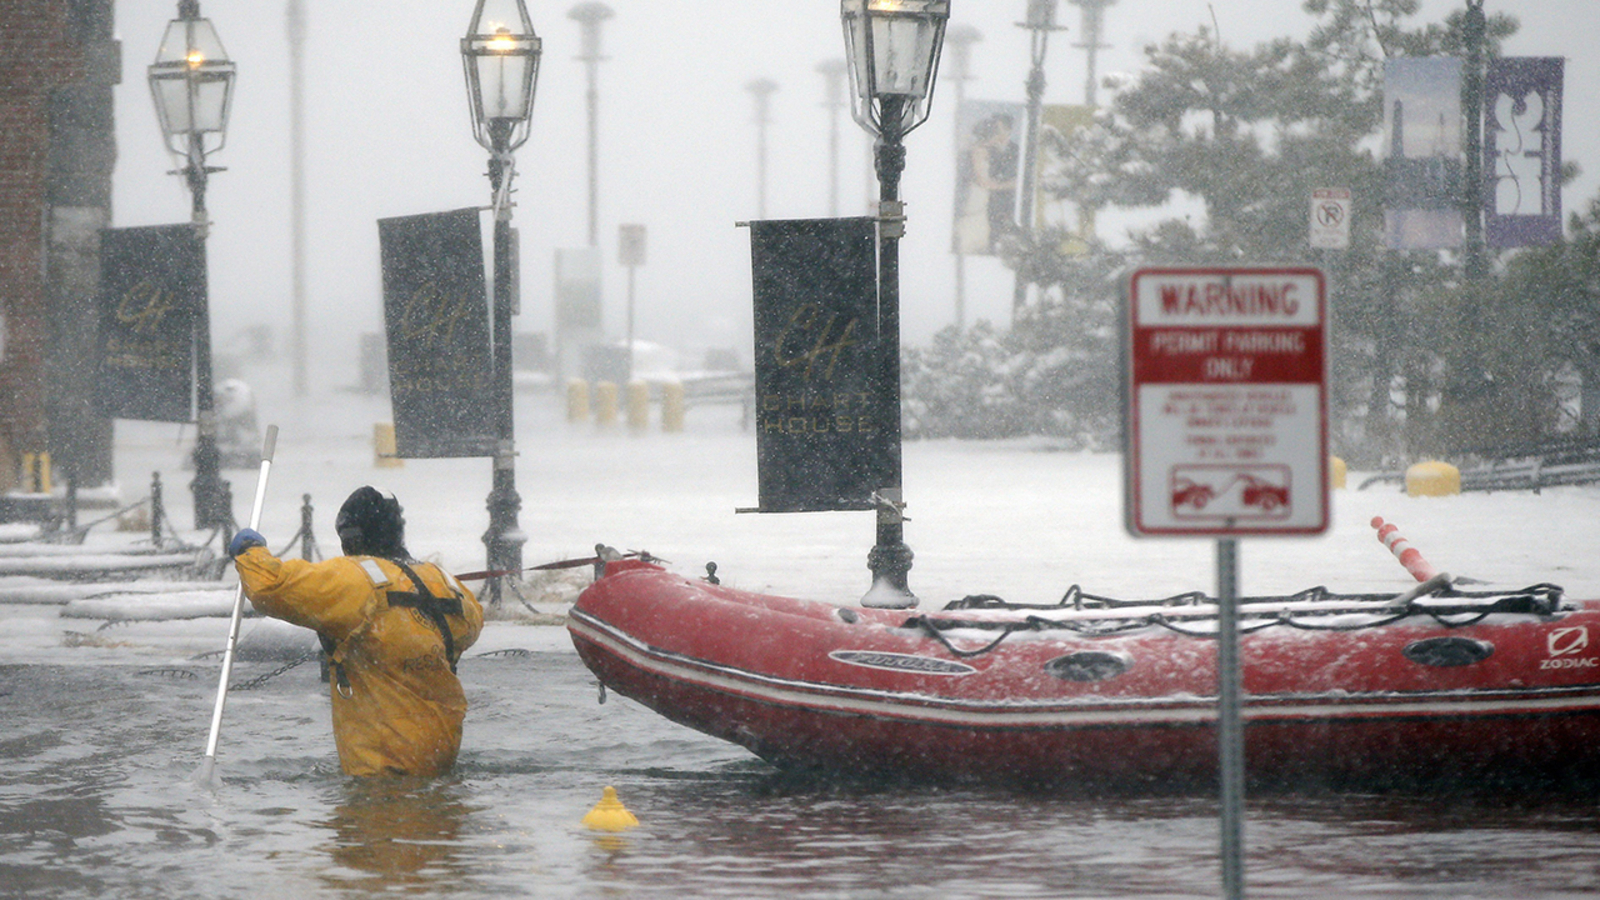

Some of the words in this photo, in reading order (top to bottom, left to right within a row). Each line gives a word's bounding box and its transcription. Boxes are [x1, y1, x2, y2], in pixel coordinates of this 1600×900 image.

[1158, 281, 1300, 316] WARNING
[1154, 331, 1219, 354] PERMIT
[1224, 331, 1306, 354] PARKING
[1205, 356, 1254, 379] ONLY
[763, 392, 873, 411] CHART
[764, 415, 875, 433] HOUSE
[1539, 657, 1600, 670] ZODIAC
